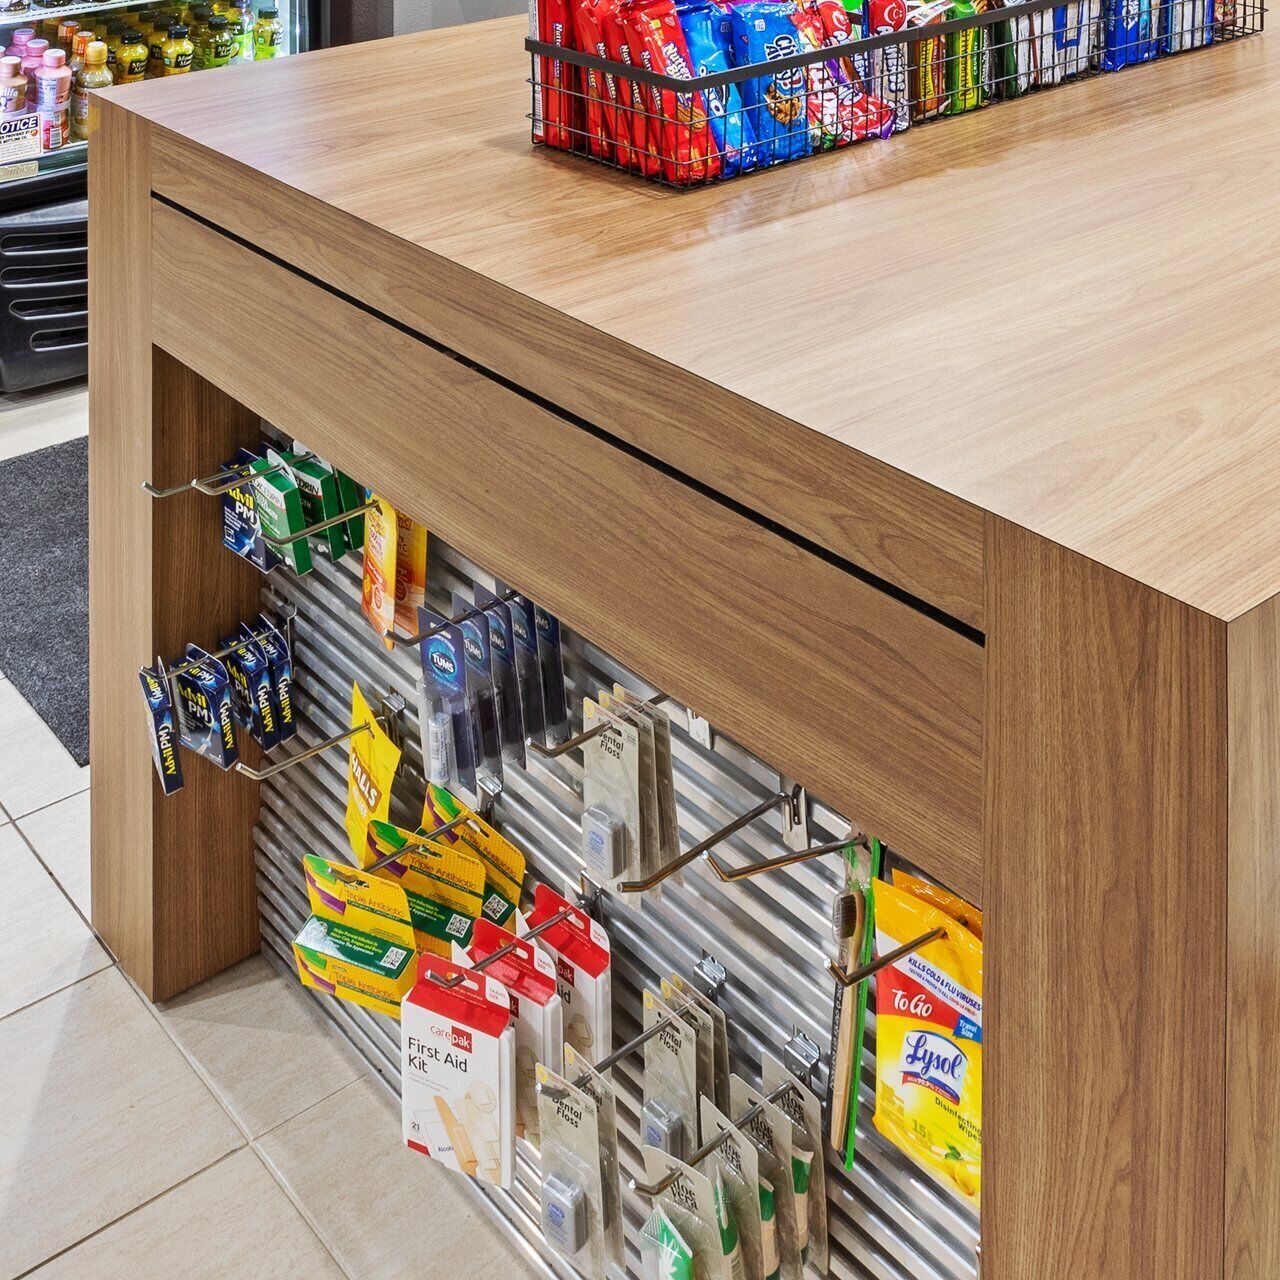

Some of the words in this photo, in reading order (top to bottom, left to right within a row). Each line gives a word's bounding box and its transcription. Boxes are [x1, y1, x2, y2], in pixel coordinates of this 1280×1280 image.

[0, 116, 38, 134] OTICE
[235, 501, 254, 523] PM
[465, 640, 482, 660] TUMS
[433, 653, 455, 673] TUMS
[178, 683, 206, 708] Advil
[258, 686, 270, 708] PM
[188, 701, 208, 721] PM
[220, 702, 231, 724] PM
[262, 706, 274, 732] Advil
[159, 724, 170, 748] PM
[223, 723, 234, 749] Advil
[163, 746, 177, 775] Advil
[600, 740, 621, 760] Floss
[351, 753, 378, 807] HALLS
[411, 857, 434, 873] Triple
[436, 867, 477, 891] Antibiotic
[347, 890, 367, 904] Triple
[907, 956, 926, 972] KILLS
[926, 967, 940, 983] COLD
[944, 980, 957, 995] FLU
[956, 989, 982, 1011] VIRUSES
[892, 988, 909, 1011] To
[909, 994, 933, 1017] Go
[959, 1019, 978, 1033] Travel
[961, 1028, 973, 1038] Size
[408, 1037, 440, 1061] First
[444, 1053, 468, 1072] Aid
[659, 1033, 679, 1056] Floss
[408, 1054, 428, 1073] Kit
[906, 1034, 963, 1079] Lysol
[556, 1107, 579, 1128] Floss
[721, 1147, 742, 1173] Vera
[671, 1188, 698, 1211] Vera
